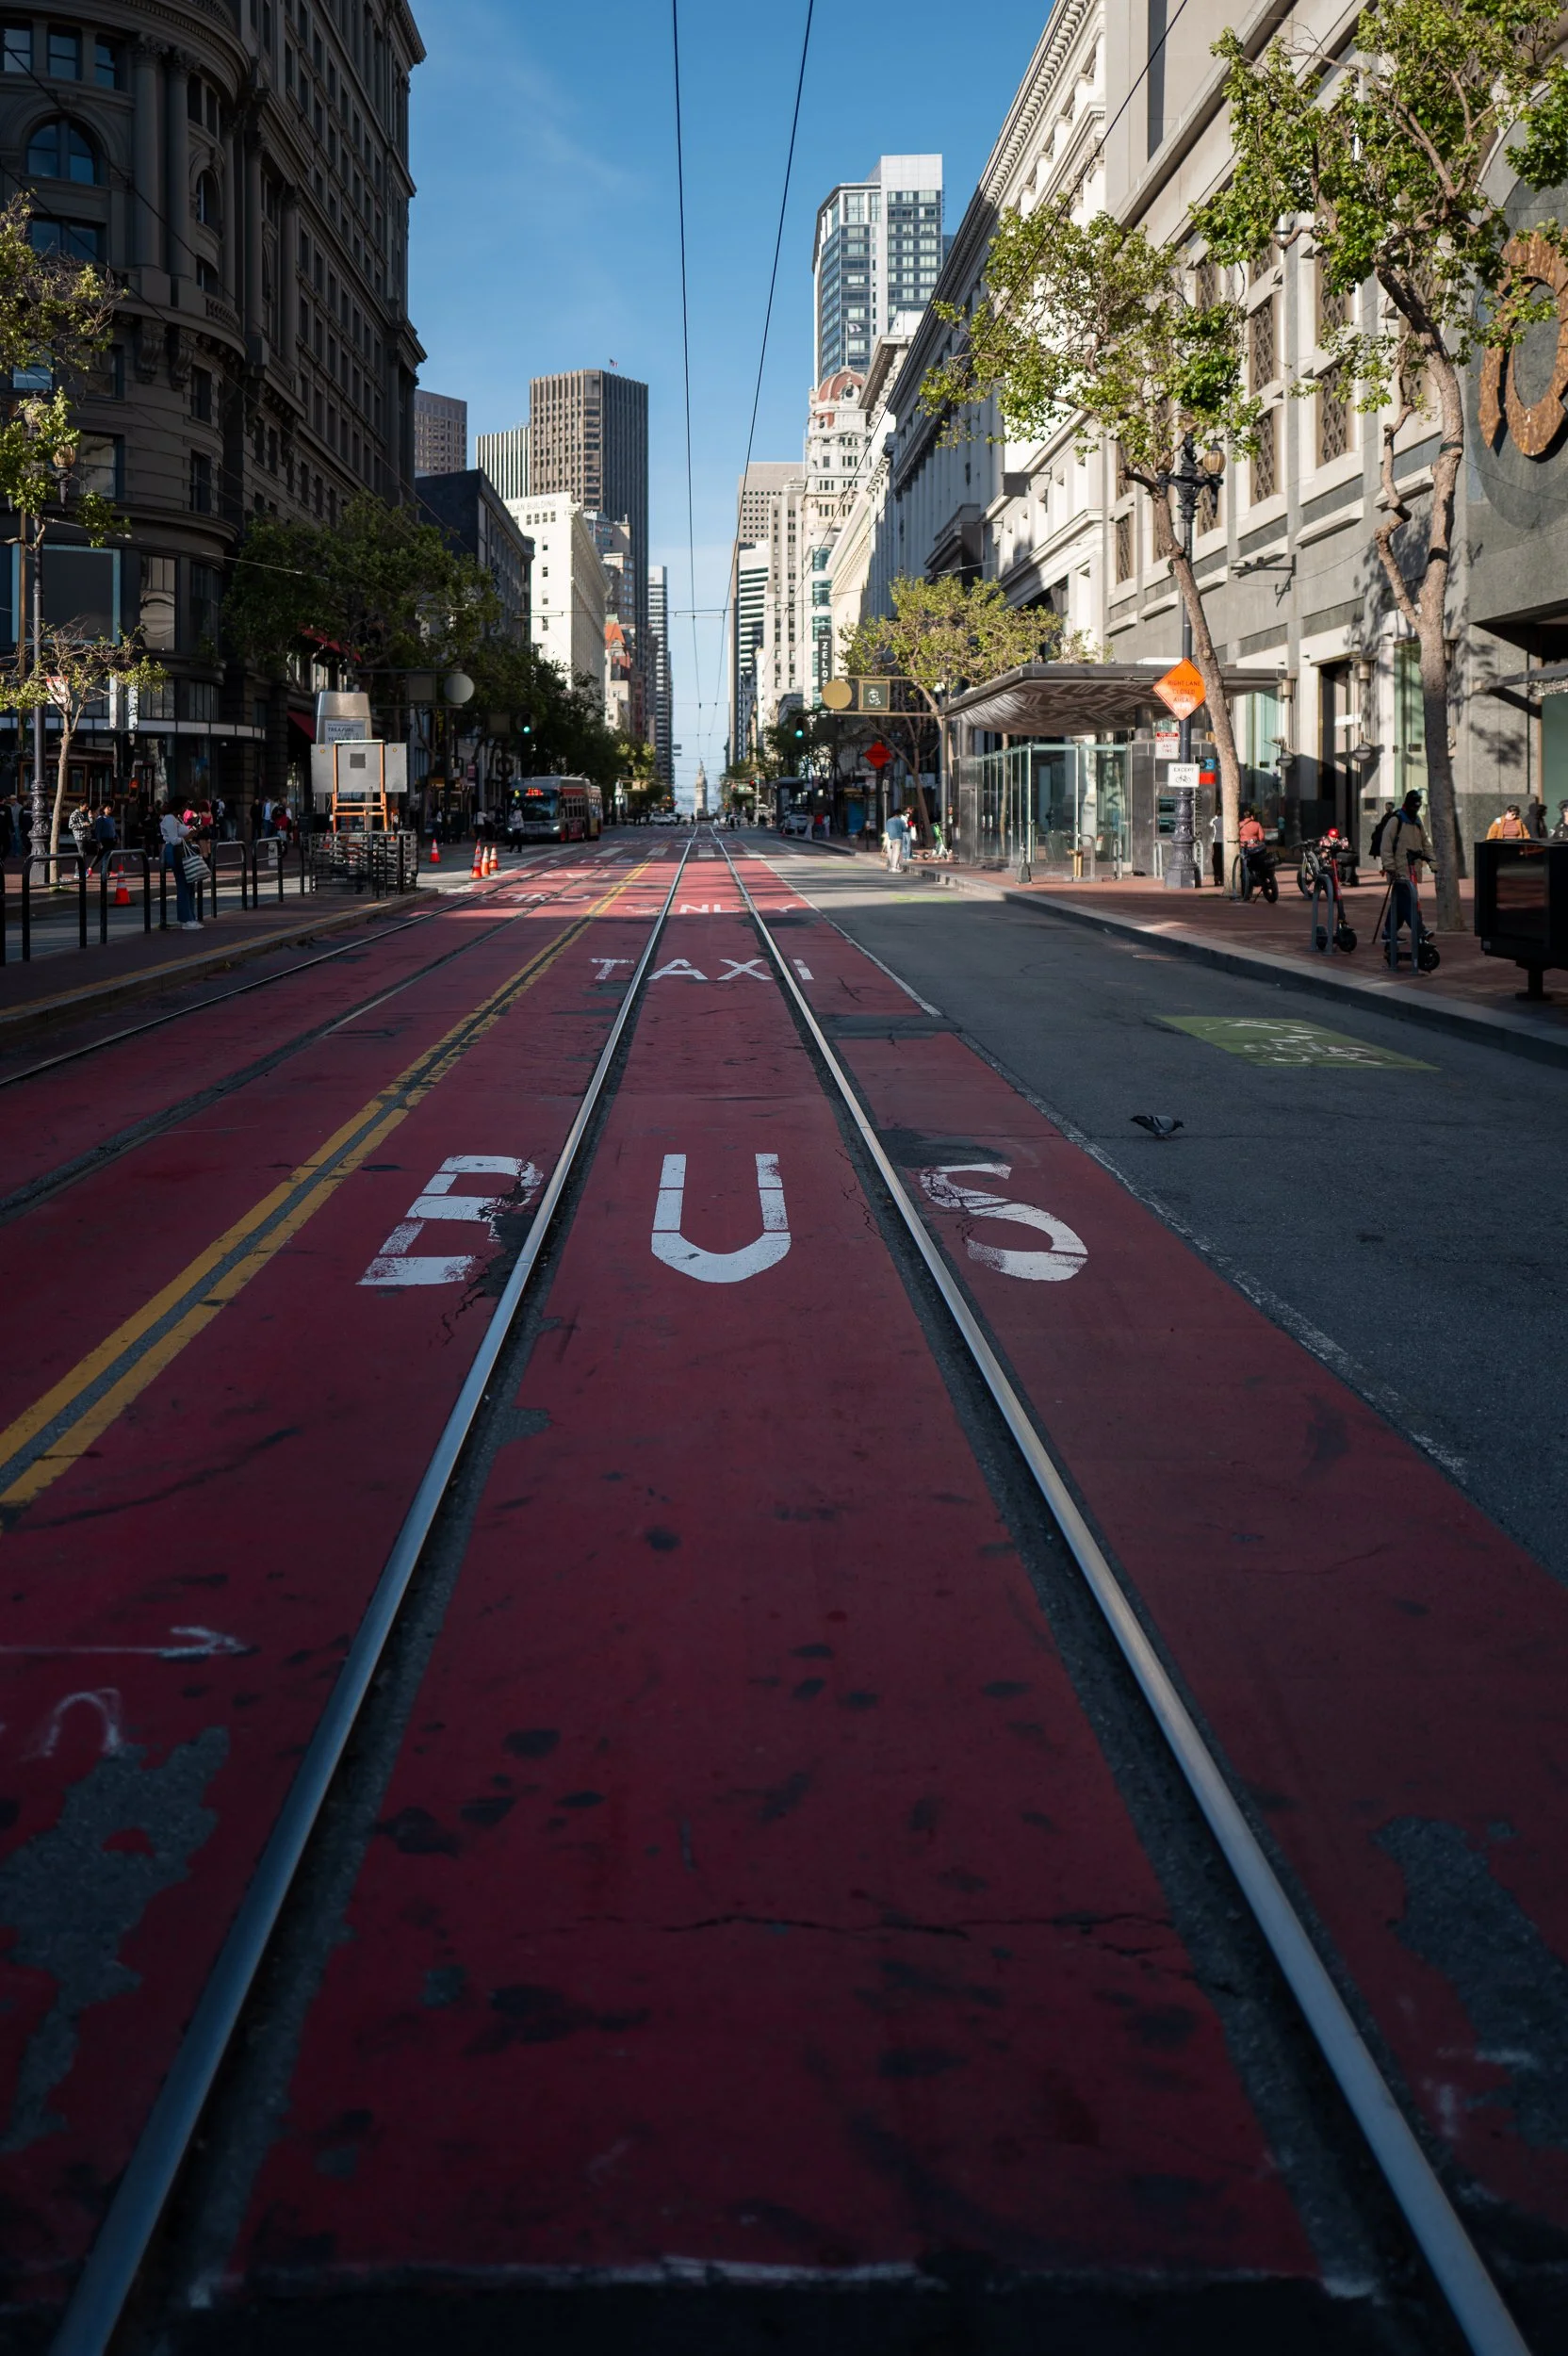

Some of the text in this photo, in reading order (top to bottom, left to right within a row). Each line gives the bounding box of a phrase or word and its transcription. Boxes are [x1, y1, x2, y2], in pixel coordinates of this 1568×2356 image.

[625, 902, 797, 915] ONLY
[588, 957, 815, 980] TAXI
[356, 1153, 1089, 1285] BUS
